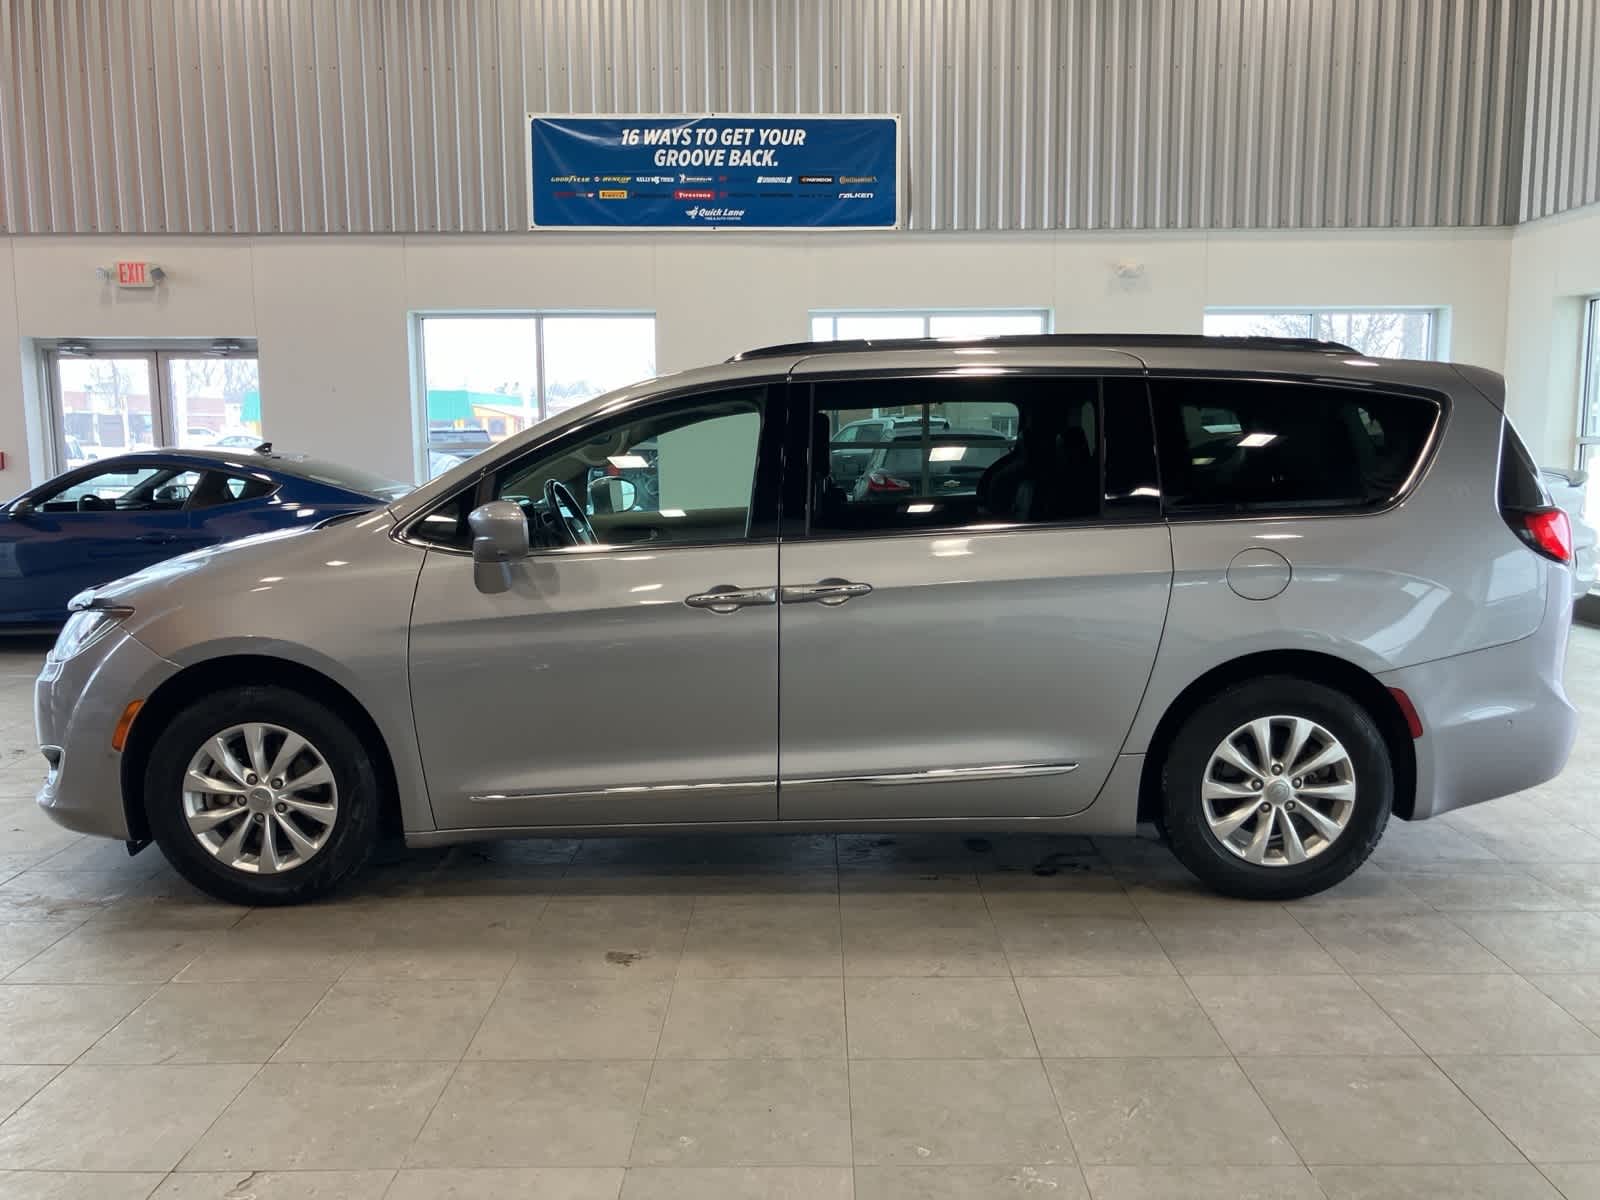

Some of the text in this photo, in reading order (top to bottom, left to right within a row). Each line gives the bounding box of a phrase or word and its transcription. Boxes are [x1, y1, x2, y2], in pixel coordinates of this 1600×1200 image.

[621, 128, 806, 146] 16 WAYS TO GET YOUR
[654, 149, 779, 167] GROOVE BACK.
[699, 208, 745, 217] Quick Lane
[119, 263, 145, 283] EXIT
